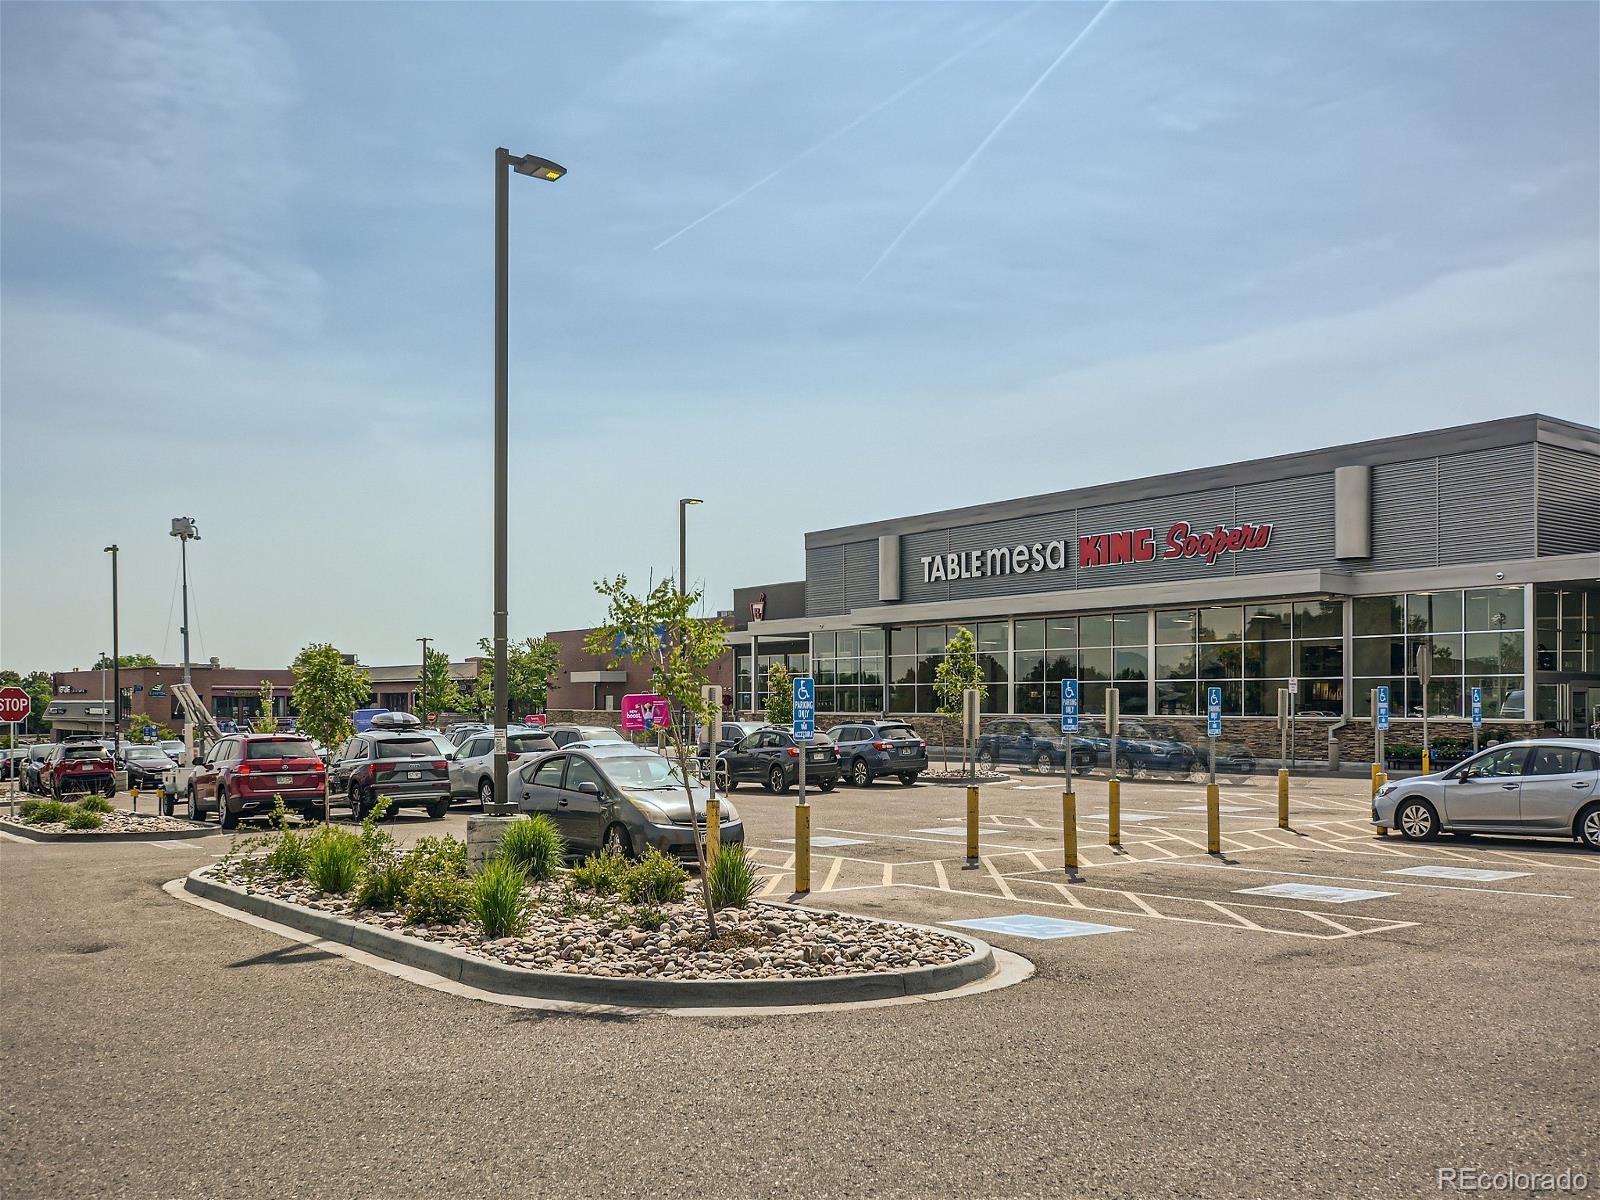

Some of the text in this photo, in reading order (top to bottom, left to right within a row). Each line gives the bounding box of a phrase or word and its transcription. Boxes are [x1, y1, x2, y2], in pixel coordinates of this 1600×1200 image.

[1078, 521, 1273, 568] KING Soopers
[921, 540, 1065, 583] TABLE mesa
[0, 698, 28, 711] STOP
[794, 701, 813, 709] PARKING
